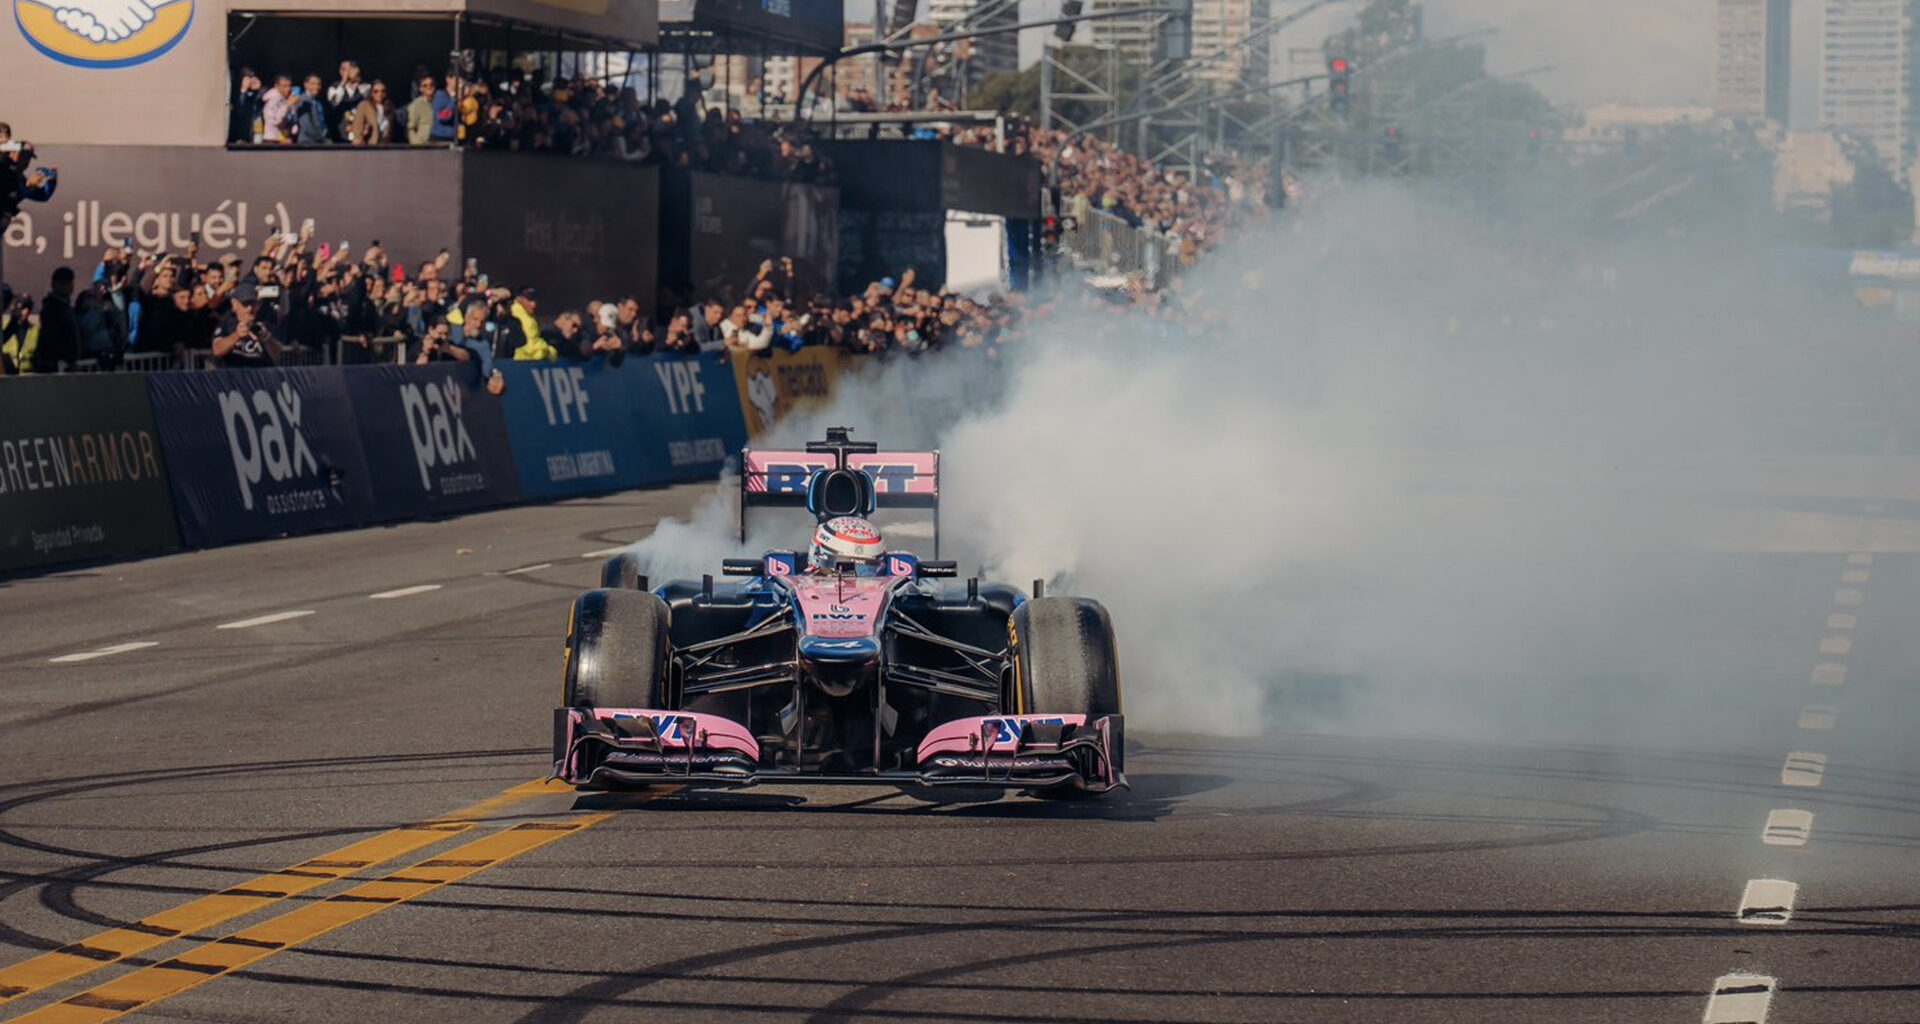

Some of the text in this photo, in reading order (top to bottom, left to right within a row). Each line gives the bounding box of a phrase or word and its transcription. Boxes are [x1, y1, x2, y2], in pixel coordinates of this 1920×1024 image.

[531, 367, 589, 426] YPF
[654, 360, 706, 414] YPF
[218, 381, 318, 510] pax
[400, 375, 477, 491] pax
